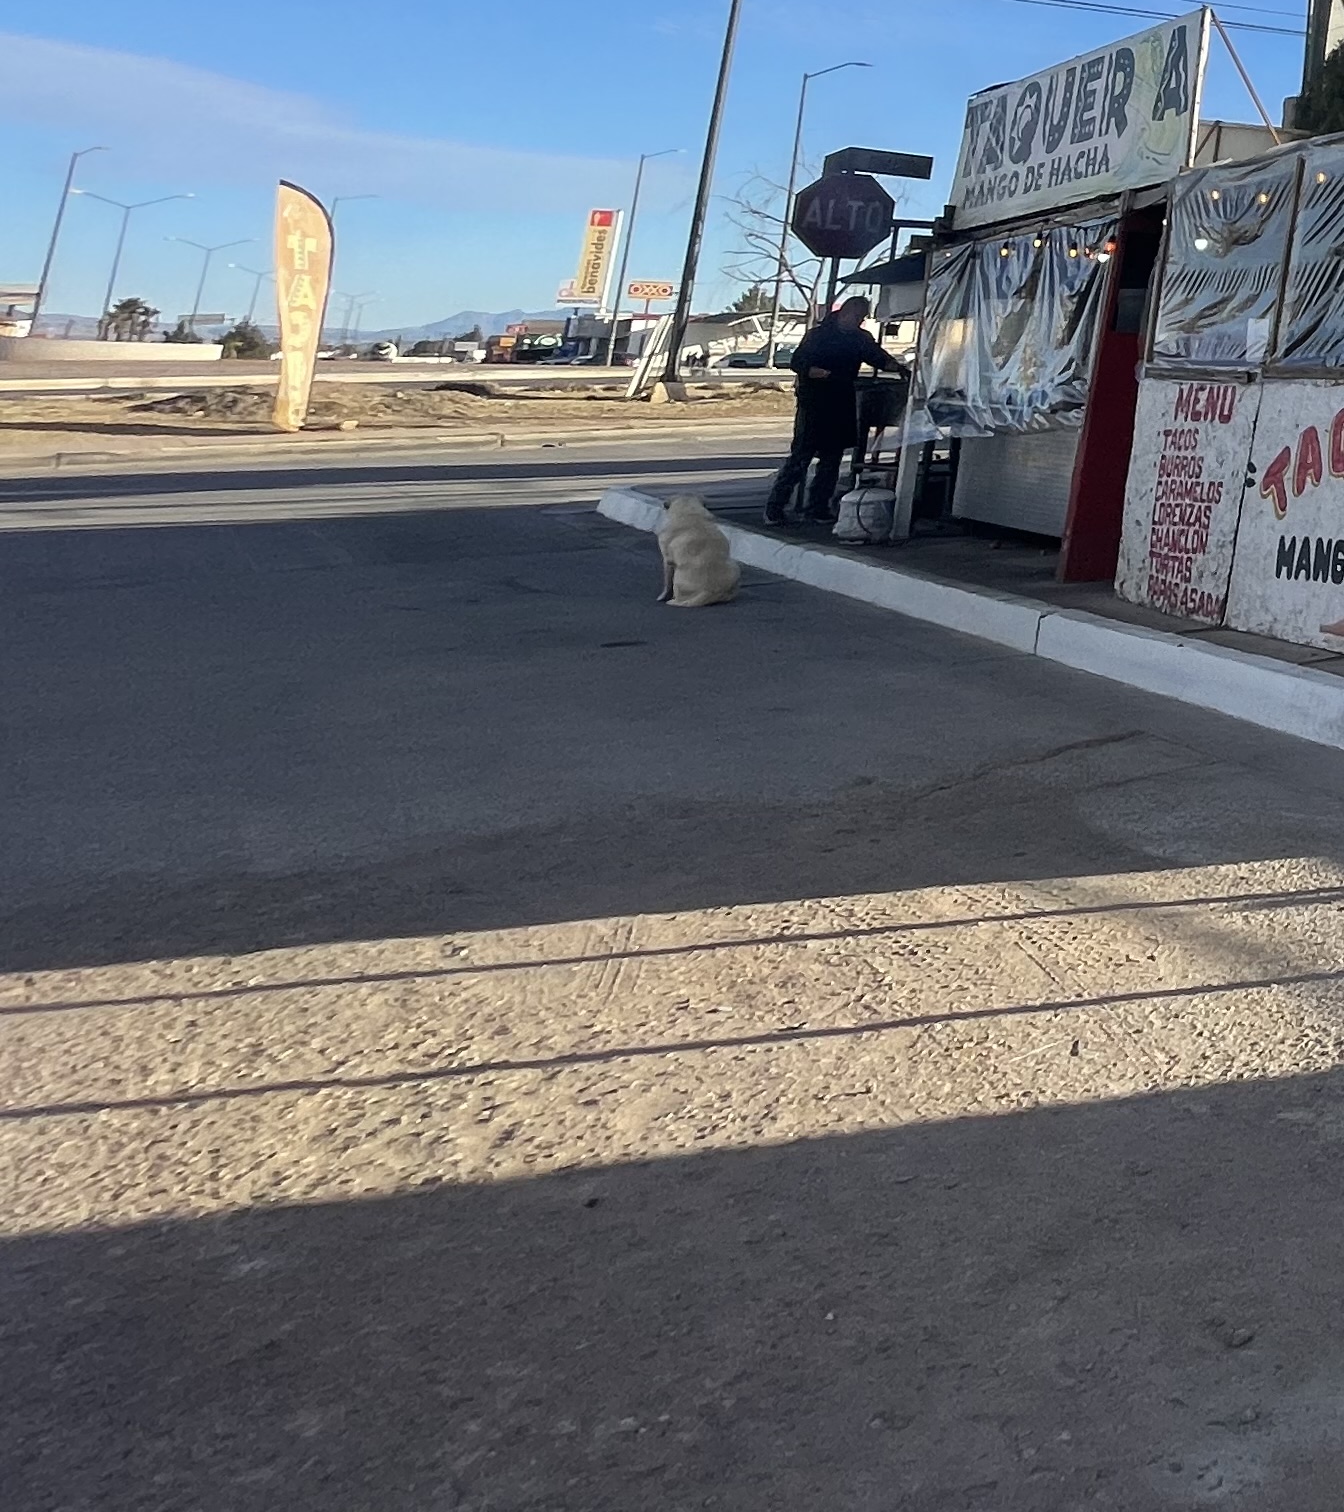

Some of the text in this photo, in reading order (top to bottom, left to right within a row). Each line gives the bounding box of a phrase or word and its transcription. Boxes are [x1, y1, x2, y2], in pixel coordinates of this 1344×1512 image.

[963, 143, 1111, 210] MANGO DE HACHA
[801, 196, 885, 233] ALTO
[581, 229, 609, 294] benavides
[629, 283, 674, 297] OXXO
[1173, 382, 1237, 425] MENU
[1162, 427, 1200, 452] TACOS
[1158, 454, 1205, 480] BURROS
[1155, 479, 1224, 505] CARAMELOS
[1151, 500, 1212, 530] LORENZAS
[1149, 549, 1193, 584] TORTAS
